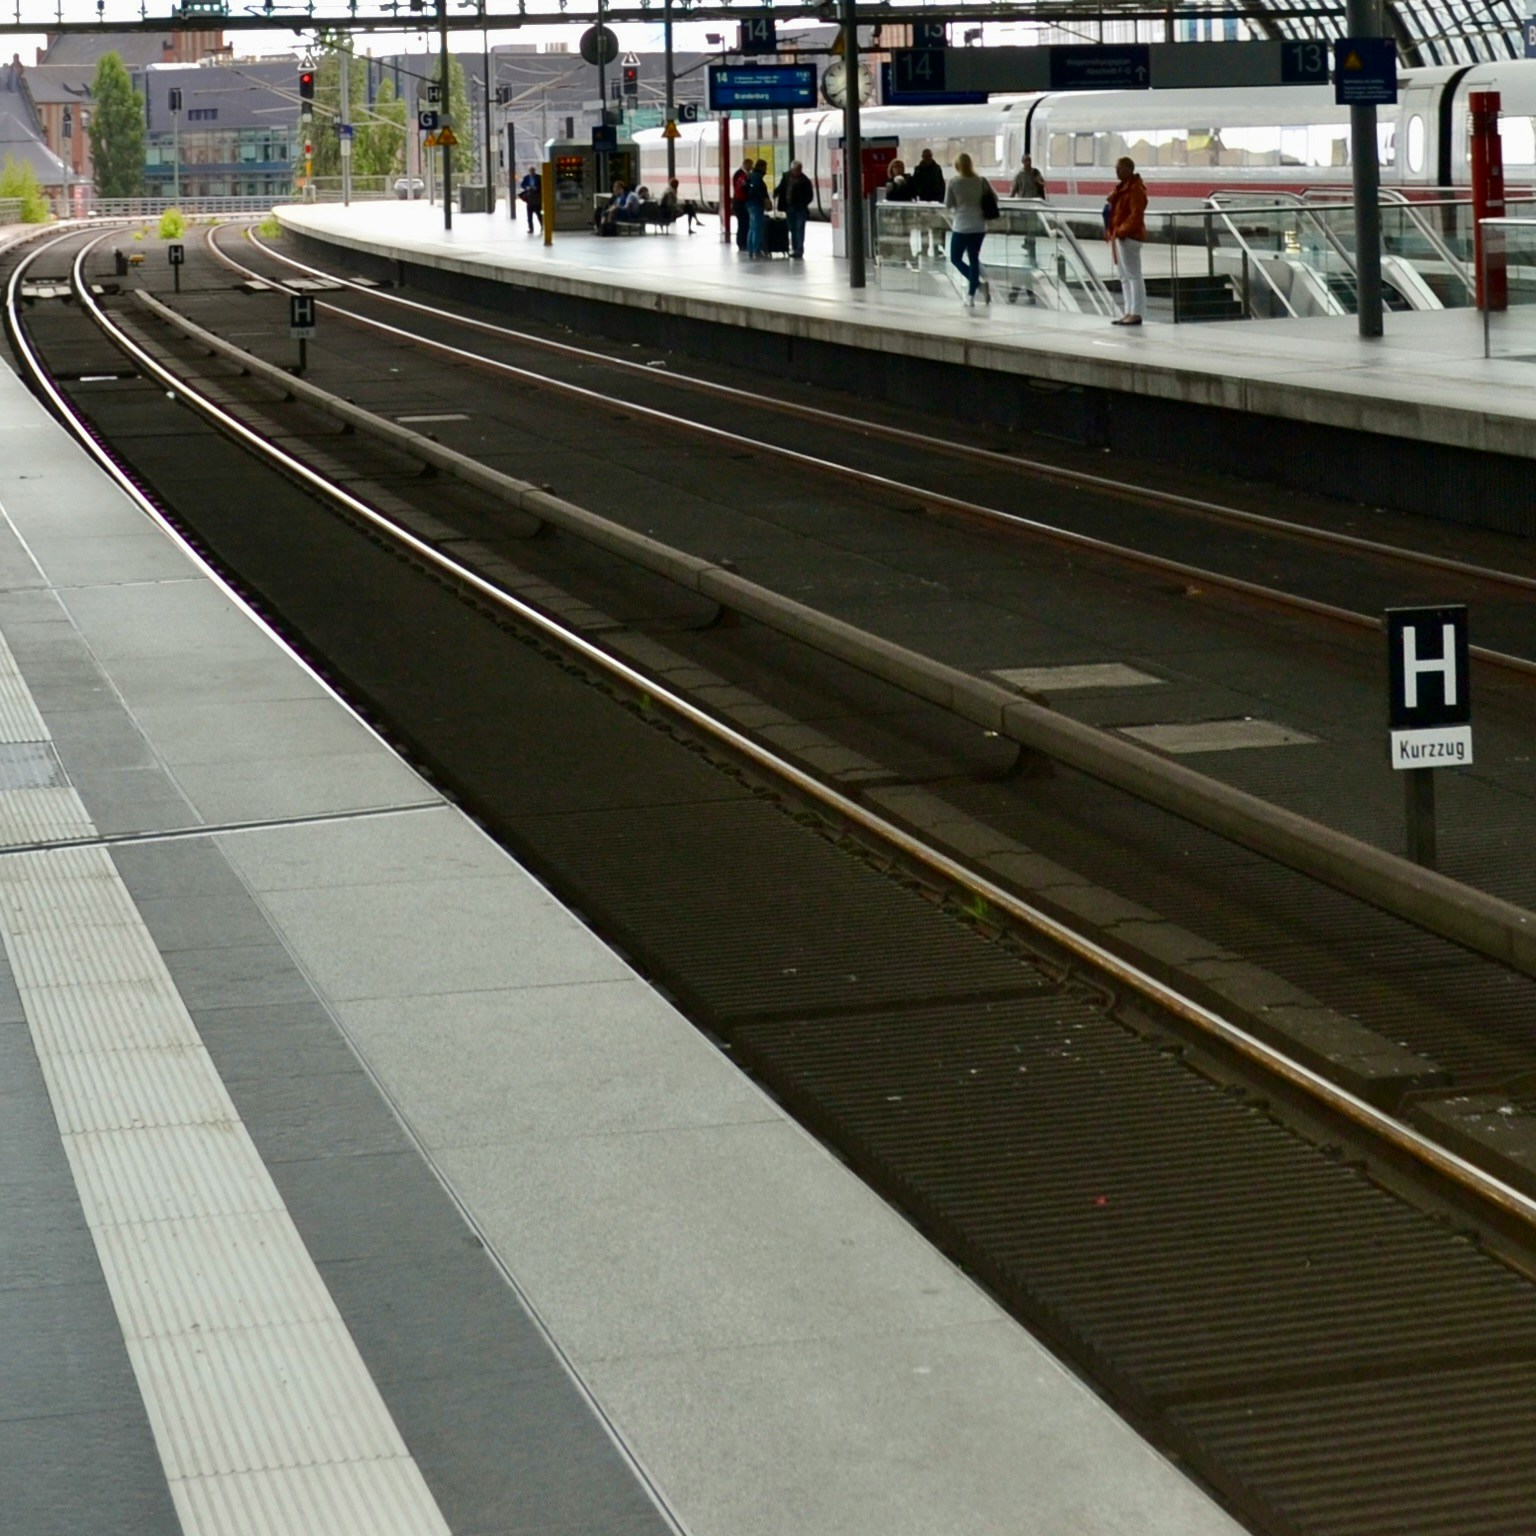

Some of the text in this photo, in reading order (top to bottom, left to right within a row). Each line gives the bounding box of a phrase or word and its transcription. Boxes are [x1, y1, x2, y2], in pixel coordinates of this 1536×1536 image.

[744, 21, 770, 40] 14
[901, 53, 933, 81] 14
[1292, 44, 1322, 73] 13
[715, 71, 728, 83] 14
[428, 86, 439, 100] H
[420, 112, 433, 127] G
[683, 104, 696, 120] G
[171, 247, 182, 262] H
[294, 298, 311, 323] H
[1403, 624, 1457, 708] H
[1400, 738, 1465, 760] Kurzzug
